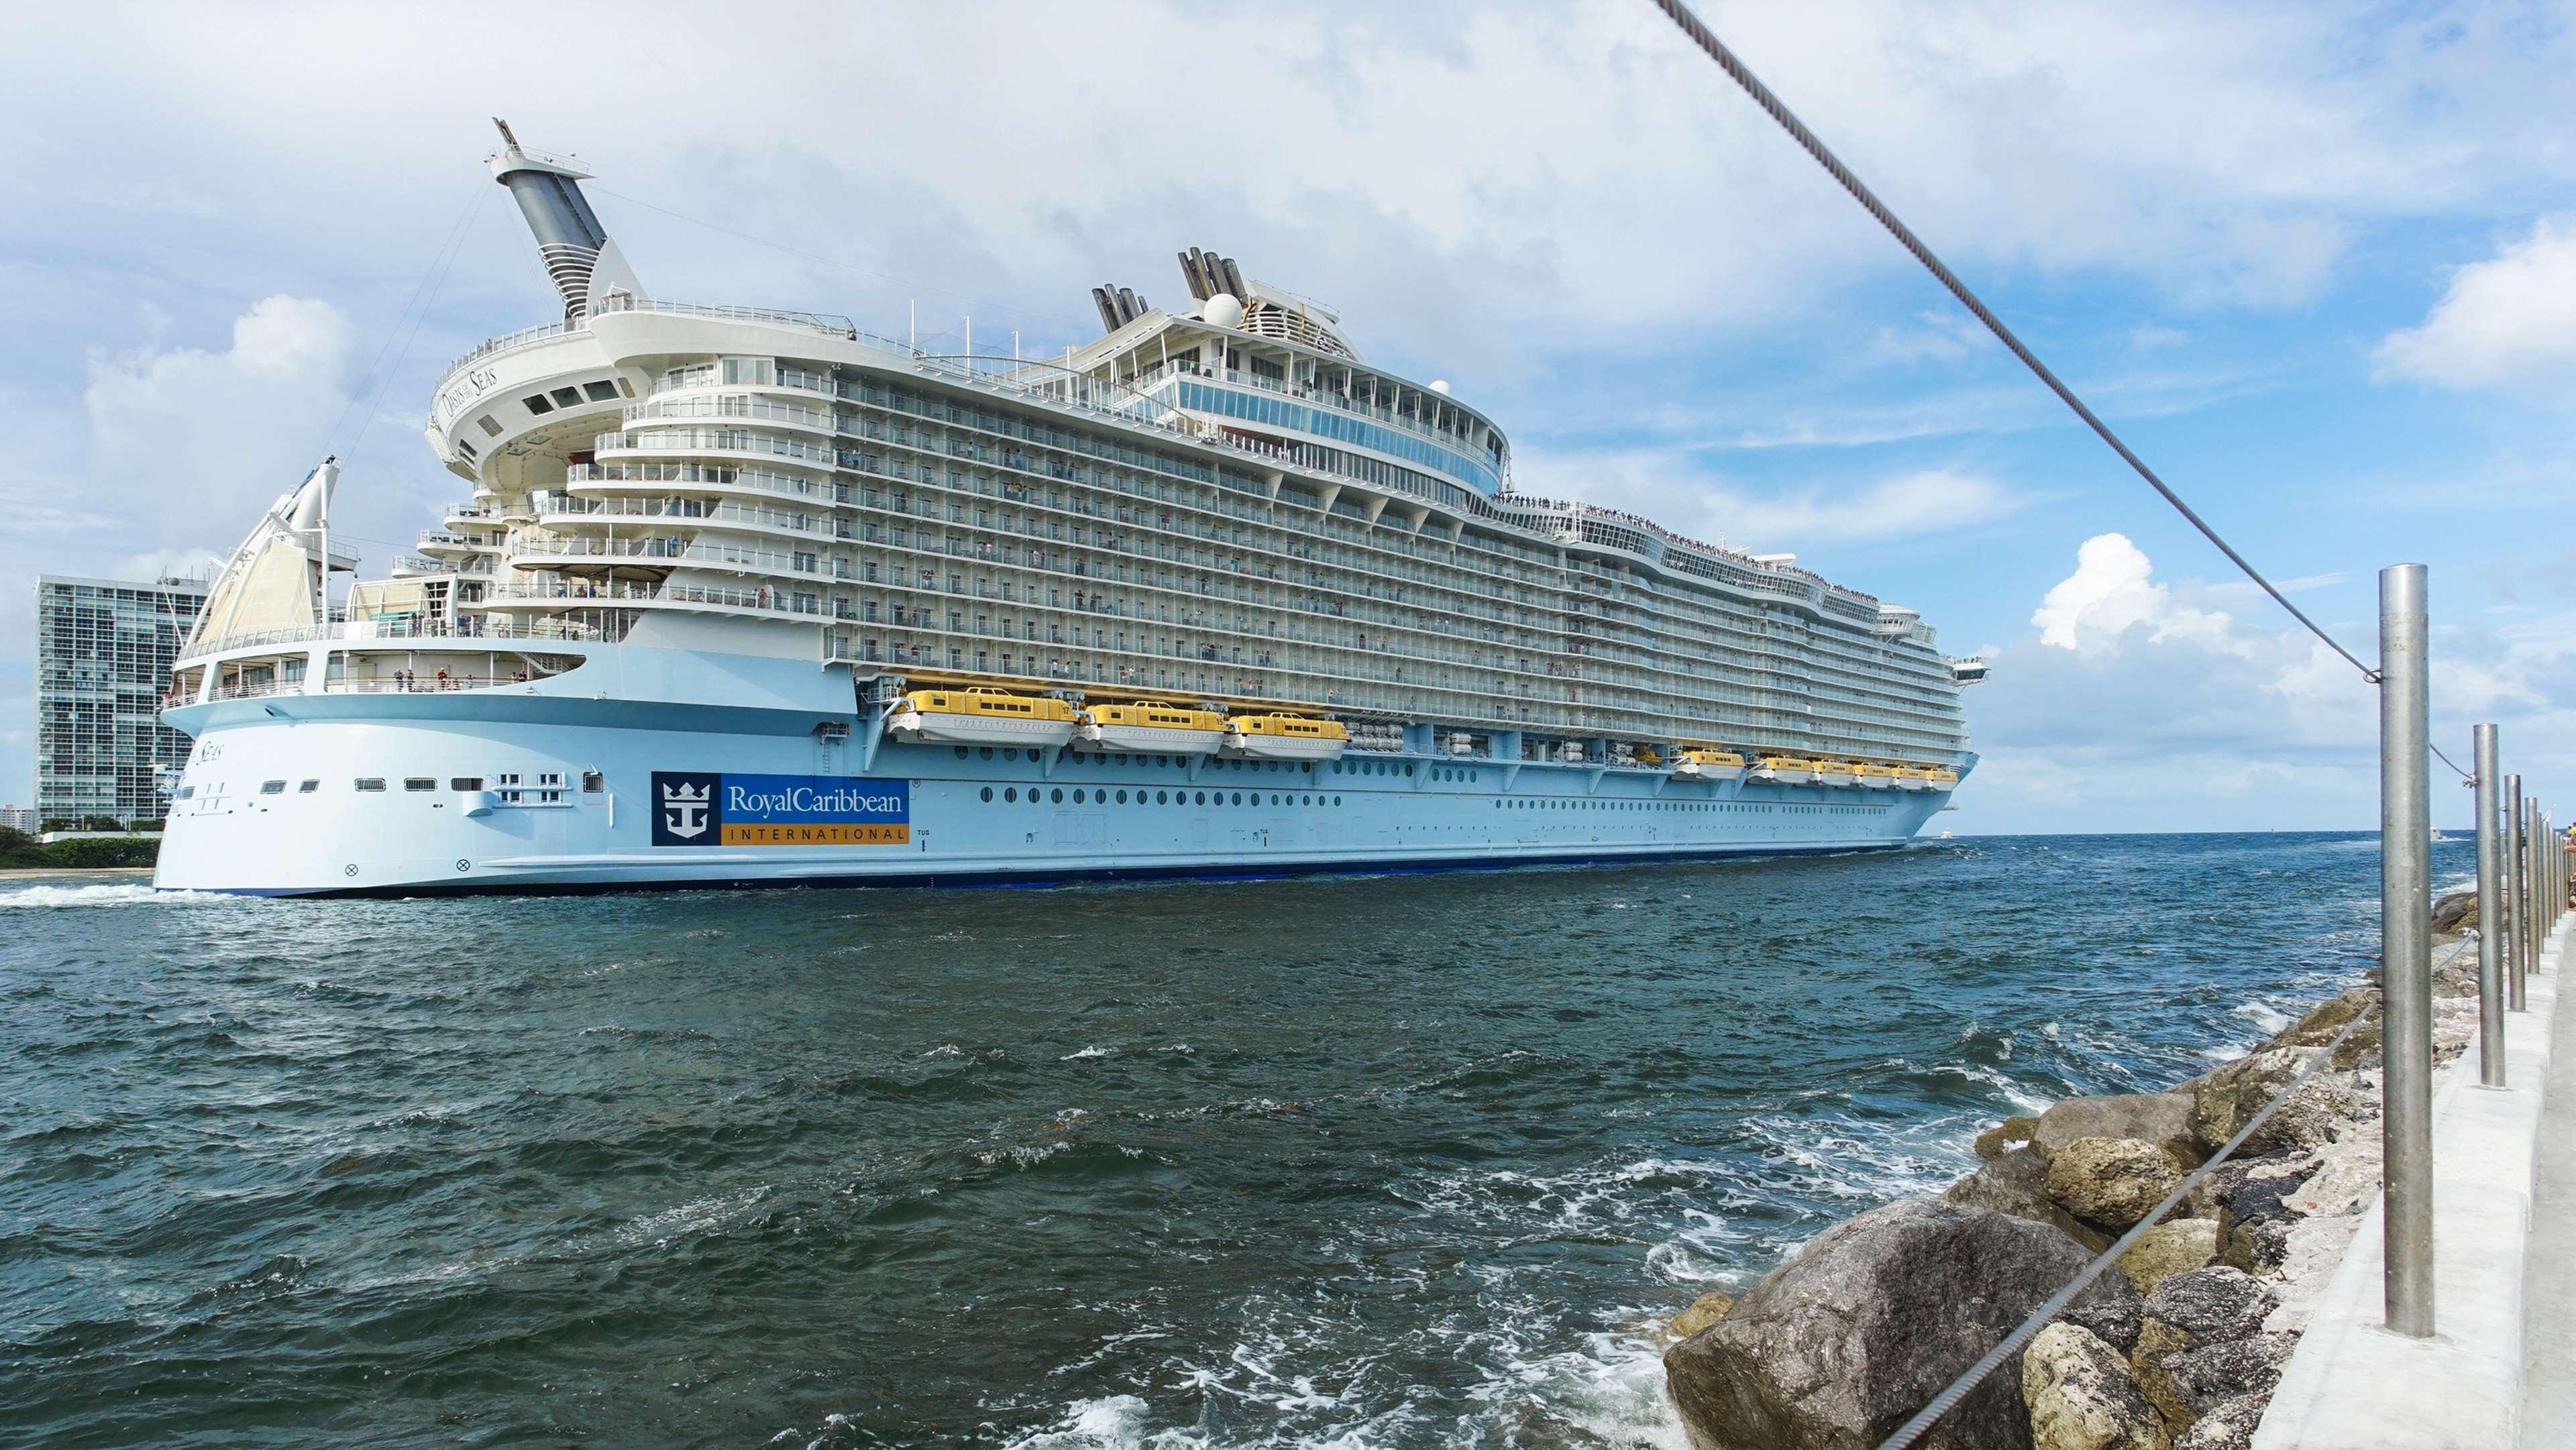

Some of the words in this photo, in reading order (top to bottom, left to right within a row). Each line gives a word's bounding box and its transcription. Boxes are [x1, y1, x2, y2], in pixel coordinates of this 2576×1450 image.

[470, 368, 497, 396] SEAS
[195, 740, 225, 766] SEAS
[730, 829, 904, 840] INTERNATIONAL
